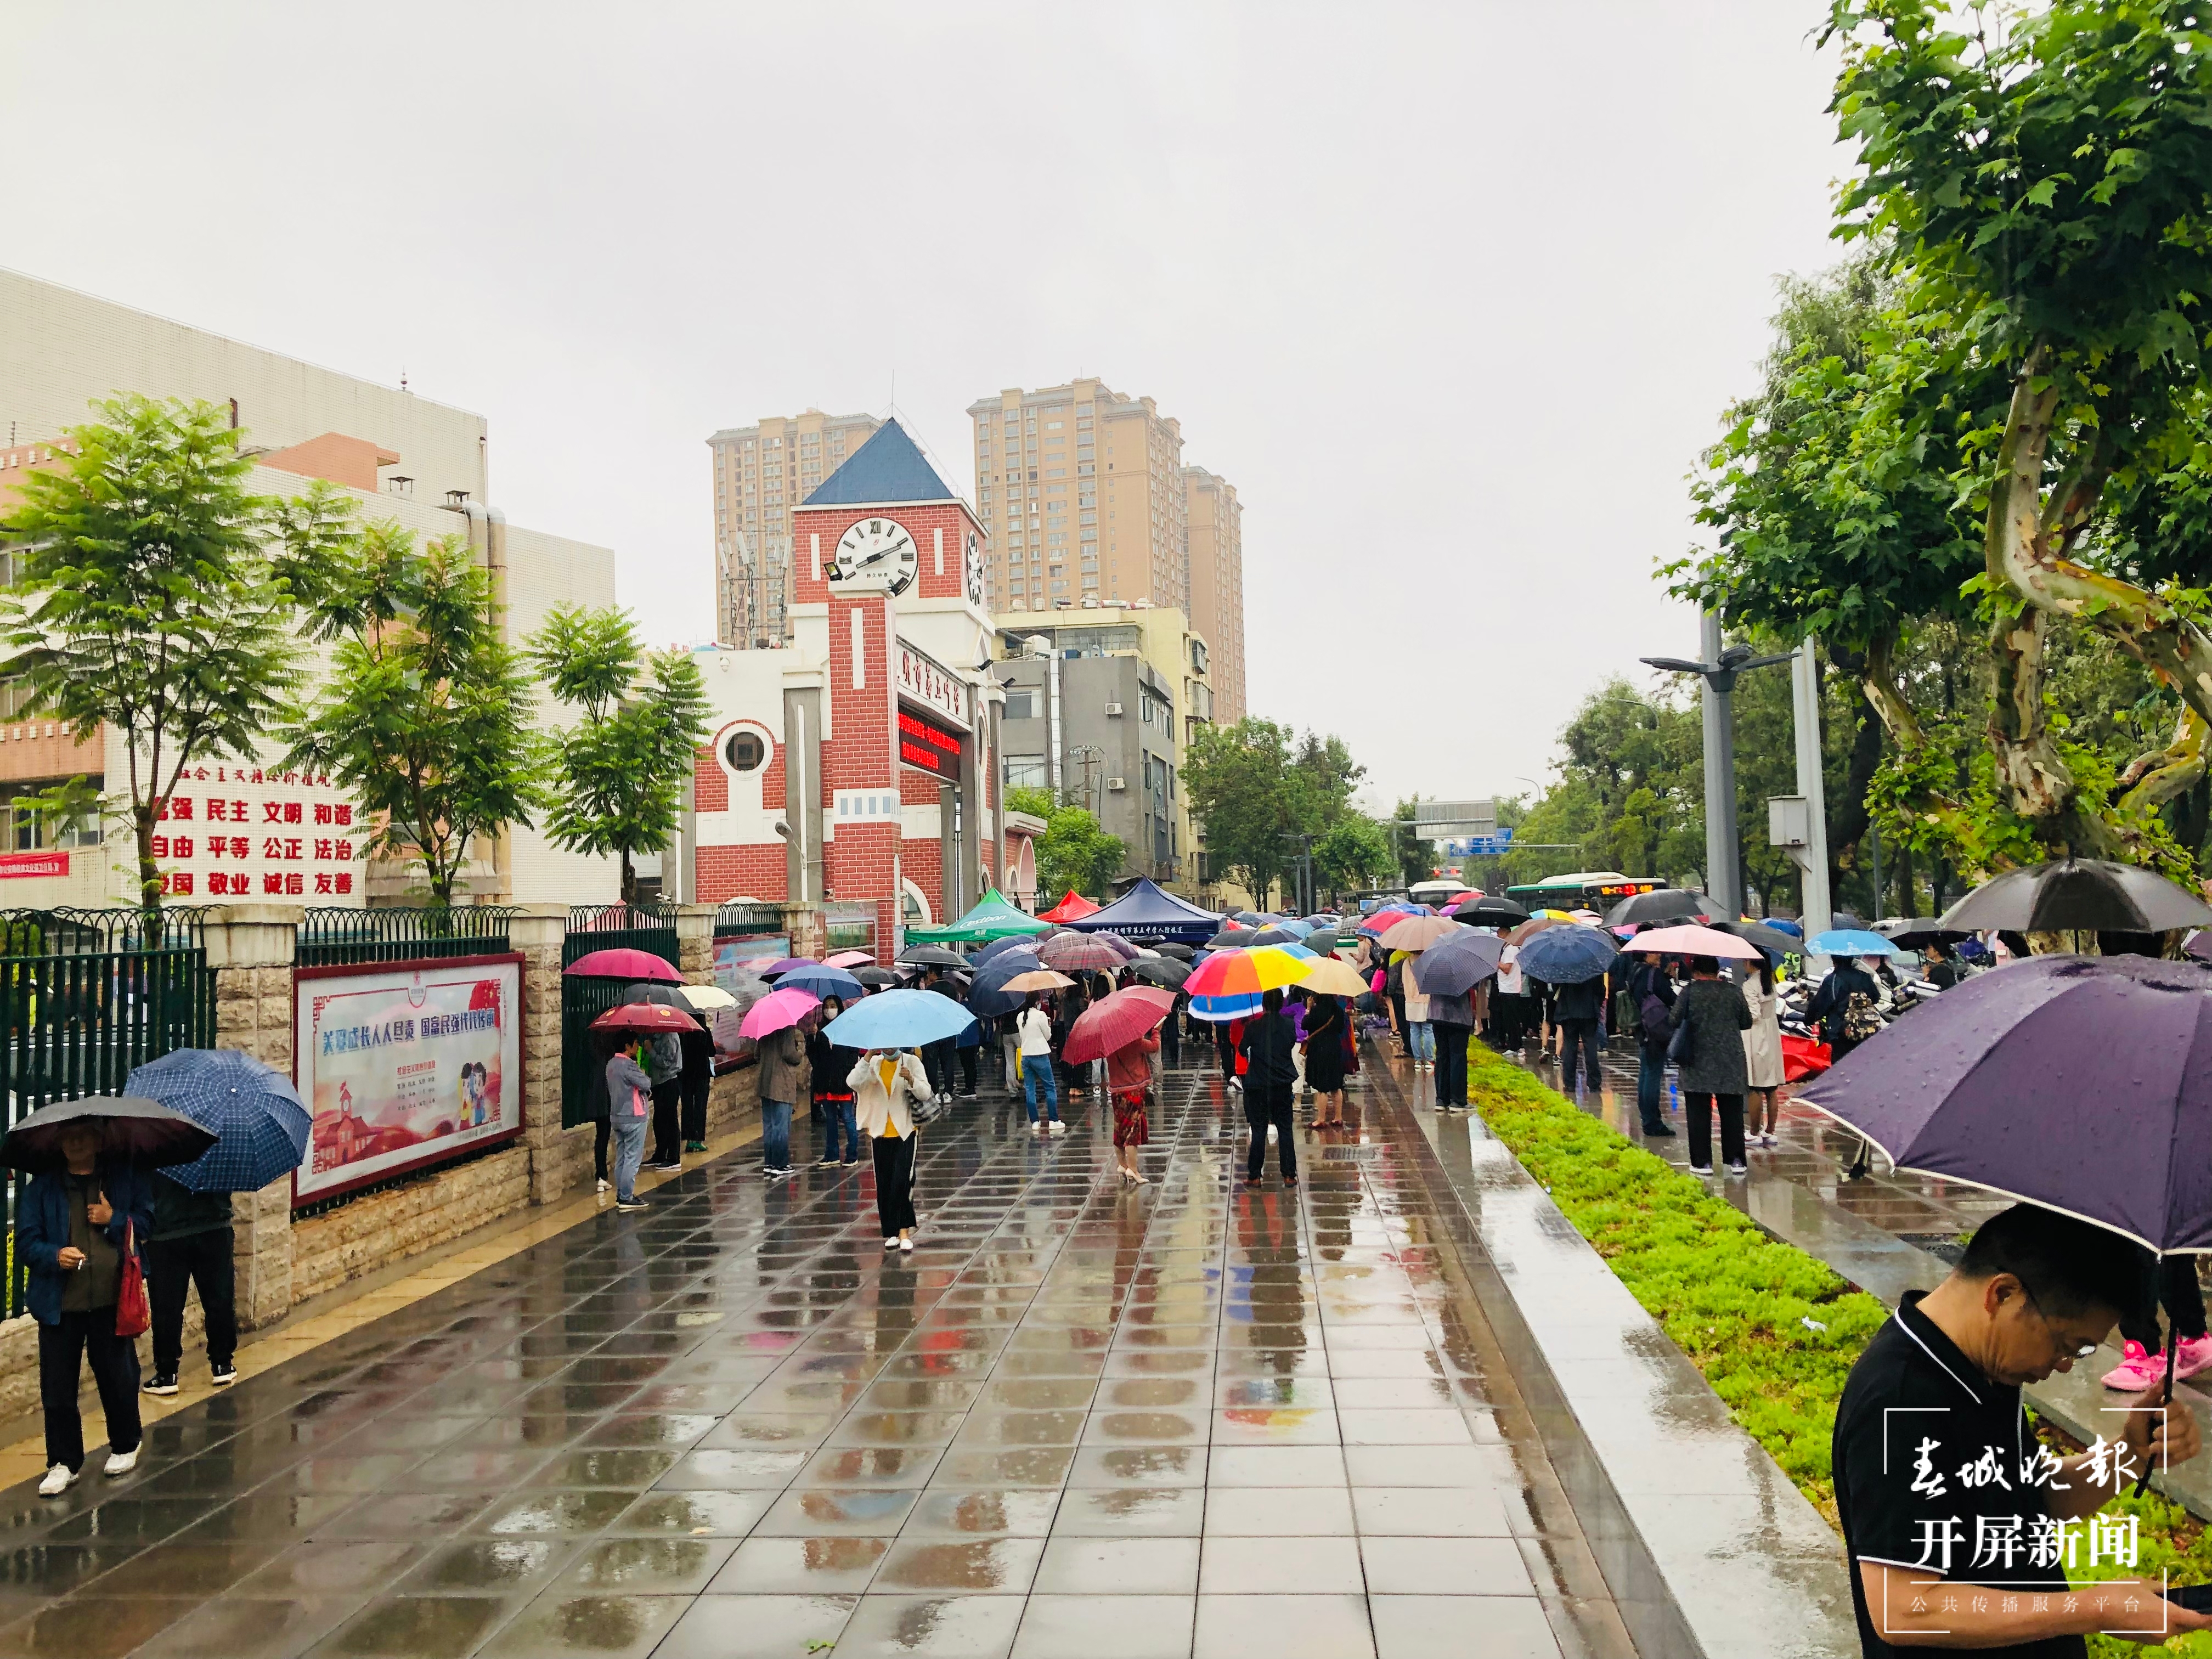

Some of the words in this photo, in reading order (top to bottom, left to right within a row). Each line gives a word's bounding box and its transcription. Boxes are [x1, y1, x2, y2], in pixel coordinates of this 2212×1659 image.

[207, 798, 250, 822] 民主
[263, 801, 302, 823] 文明
[314, 803, 352, 826] 和谐
[151, 835, 193, 857] 自由
[207, 836, 250, 859] 平等
[263, 837, 303, 860] 公正
[314, 838, 352, 860] 法治
[208, 872, 250, 895] 敬业
[263, 872, 303, 895] 诚信
[314, 873, 352, 894] 友善
